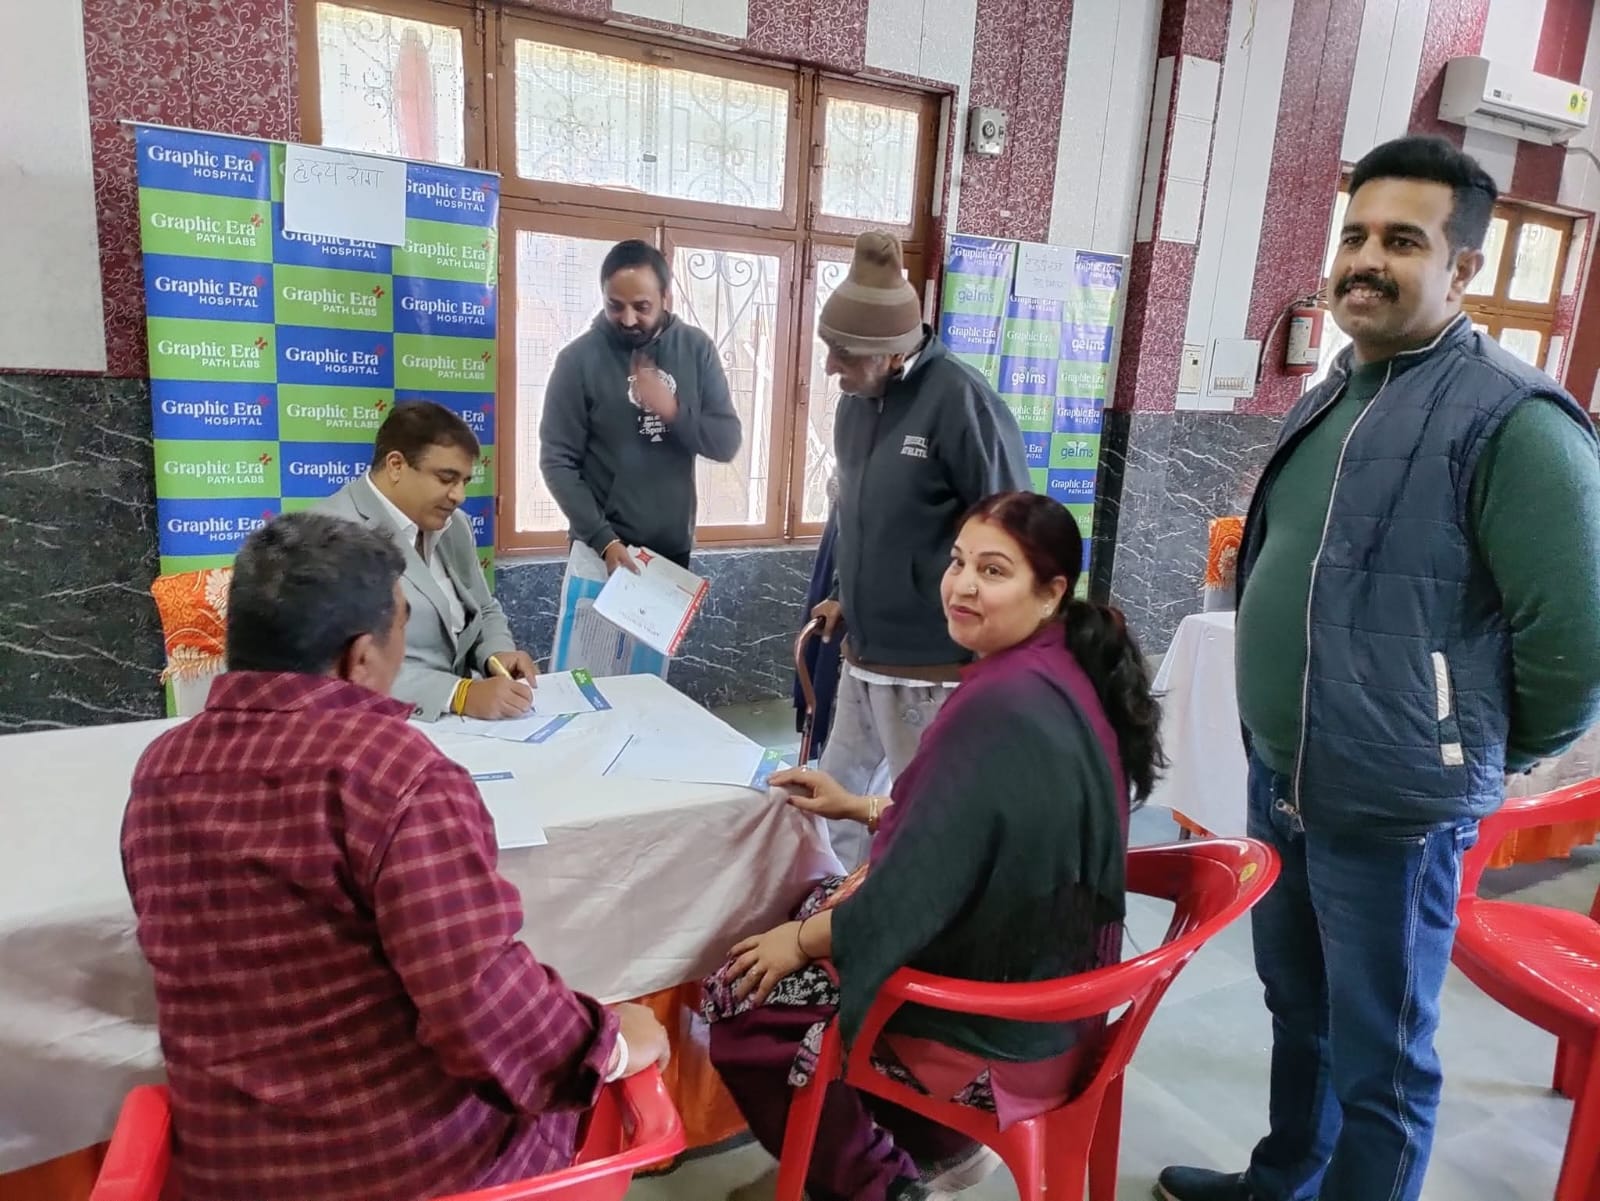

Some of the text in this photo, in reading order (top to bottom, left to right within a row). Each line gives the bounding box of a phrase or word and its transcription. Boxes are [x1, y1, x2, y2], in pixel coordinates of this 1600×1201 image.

[148, 145, 254, 172] Graphic Era
[194, 168, 254, 183] HOSPITAL
[461, 187, 485, 202] Era
[436, 198, 486, 212] HOSPITAL
[151, 212, 256, 236] Graphic Era
[196, 232, 256, 247] PATH LABS
[322, 246, 376, 259] HOSPITAL
[402, 240, 486, 260] Graphic Era
[437, 258, 486, 270] PATH LABS
[155, 276, 258, 298] Graphic Era
[200, 296, 258, 308] HOSPITAL
[282, 286, 377, 309] Graphic Era
[323, 304, 378, 316] PATH LABS
[402, 296, 485, 317] Graphic Era
[437, 314, 485, 325] HOSPITAL
[948, 326, 996, 338] Graphic Era
[158, 340, 260, 362] Graphic Era
[286, 347, 378, 368] Graphic Era
[202, 358, 260, 368] PATH LABS
[325, 364, 379, 375] HOSPITAL
[402, 352, 485, 373] Graphic Era
[438, 370, 486, 380] PATH LABS
[162, 399, 262, 420] Graphic Era
[286, 402, 379, 424] Graphic Era
[462, 410, 484, 422] Era
[1057, 408, 1100, 419] Graphic Era
[205, 416, 262, 426] HOSPITAL
[326, 419, 380, 428] PATH LABS
[1028, 444, 1042, 453] Era
[164, 459, 264, 480] Graphic Era
[290, 462, 350, 482] Graphic
[208, 475, 264, 484] PATH LABS
[1052, 480, 1094, 490] Graphic Era
[168, 518, 233, 536] Graphic
[210, 532, 249, 542] HOSPI
